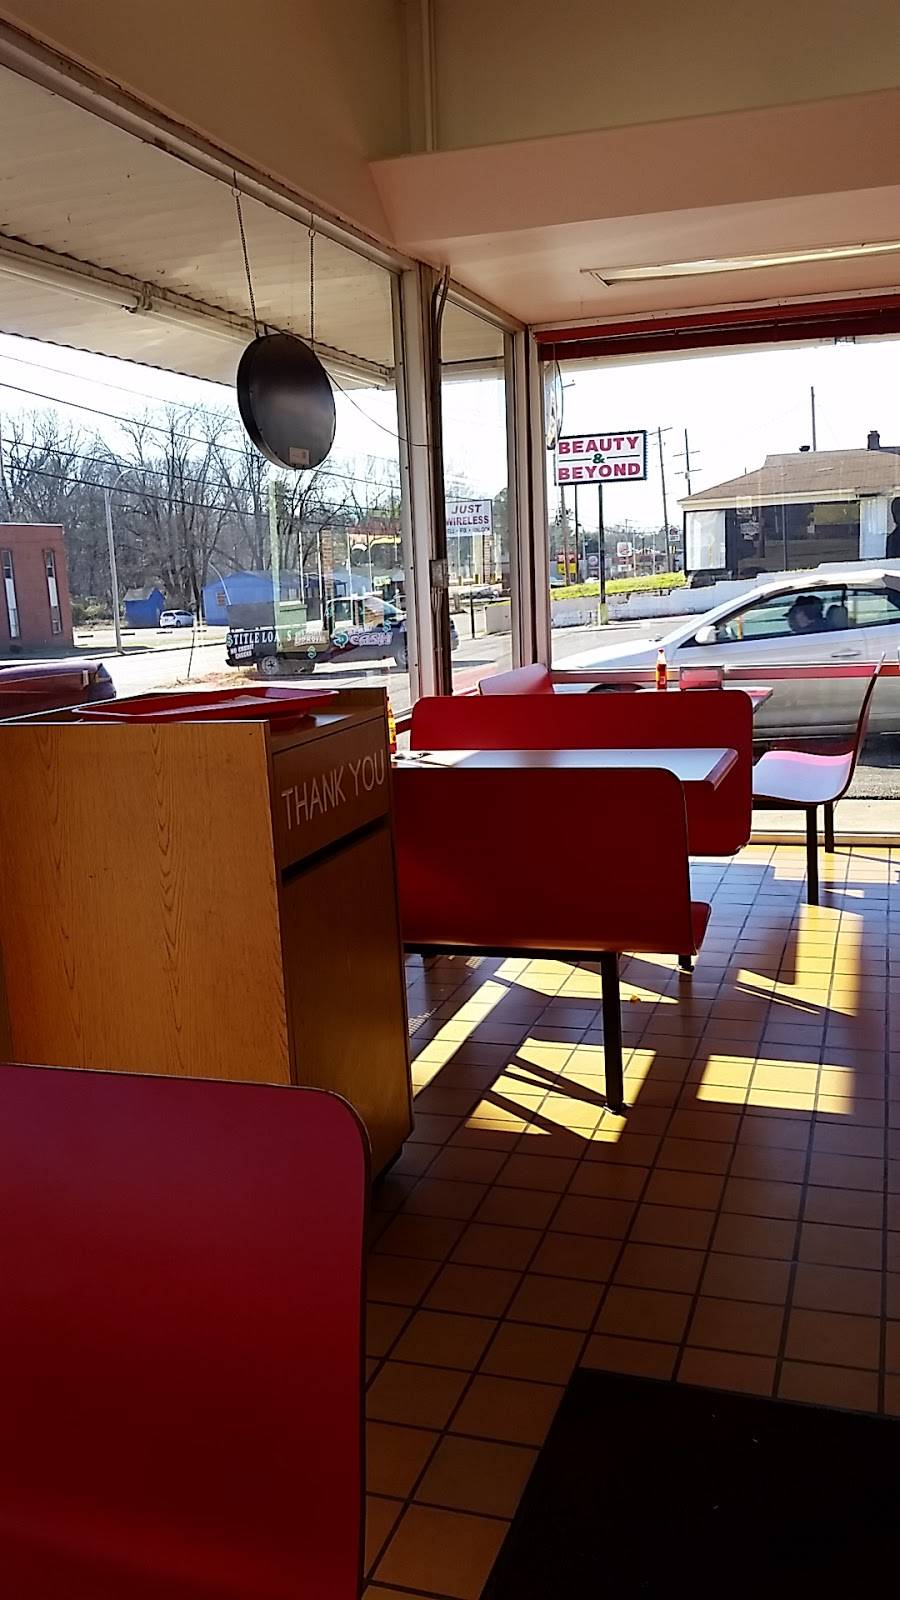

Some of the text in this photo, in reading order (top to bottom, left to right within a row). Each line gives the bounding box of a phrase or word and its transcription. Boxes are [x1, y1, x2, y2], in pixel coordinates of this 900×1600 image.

[558, 436, 640, 455] BEAUTY
[592, 453, 605, 464] &
[558, 463, 641, 480] BEYOND
[451, 504, 482, 515] JUST
[261, 629, 292, 644] LOAS
[281, 749, 386, 830] THANK YOU
